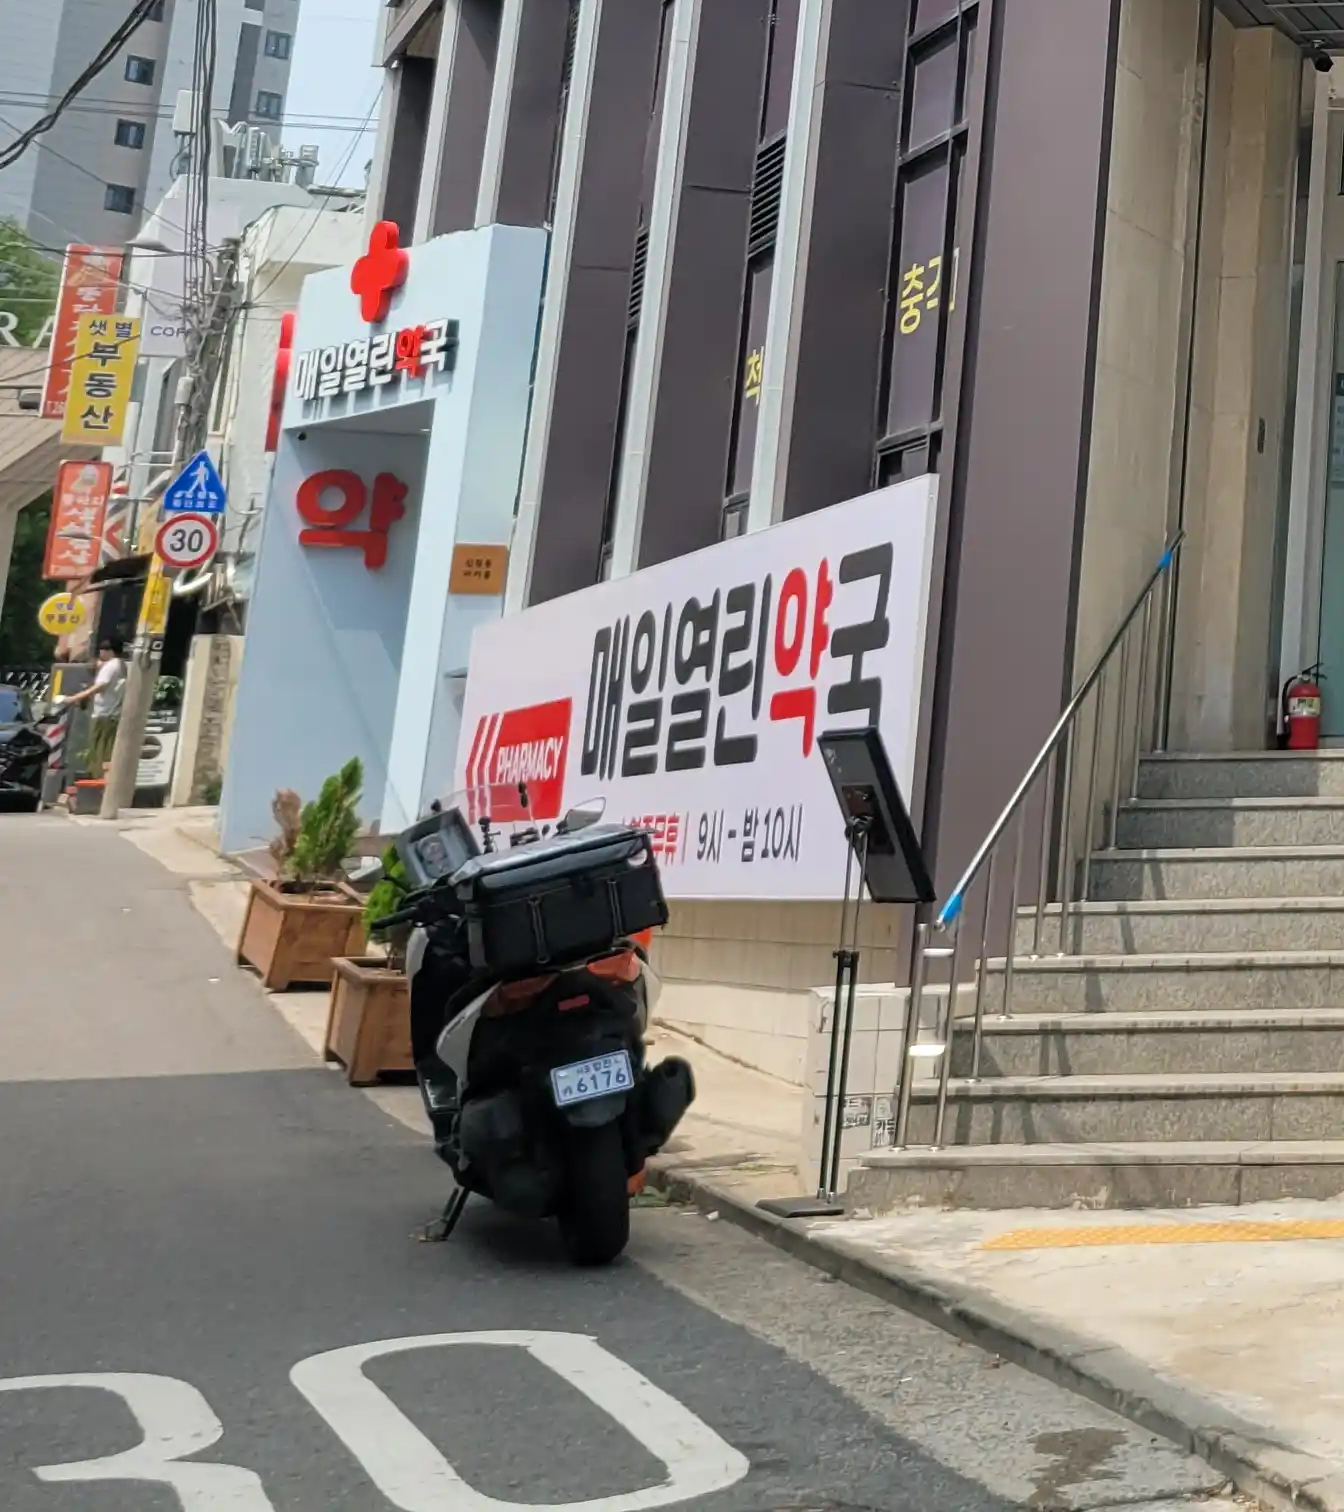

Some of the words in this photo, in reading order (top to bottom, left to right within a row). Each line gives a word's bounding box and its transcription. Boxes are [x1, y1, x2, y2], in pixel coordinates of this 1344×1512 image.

[79, 342, 122, 430] 부동산
[296, 318, 450, 401] 매일열린약국
[169, 528, 204, 553] 30
[296, 469, 409, 570] 약
[580, 541, 895, 782] 매일열린약국
[496, 736, 565, 784] PHARMACY
[697, 809, 724, 864] 9시
[741, 806, 760, 863] 밤
[761, 804, 803, 863] 10시
[577, 1068, 626, 1093] 6176
